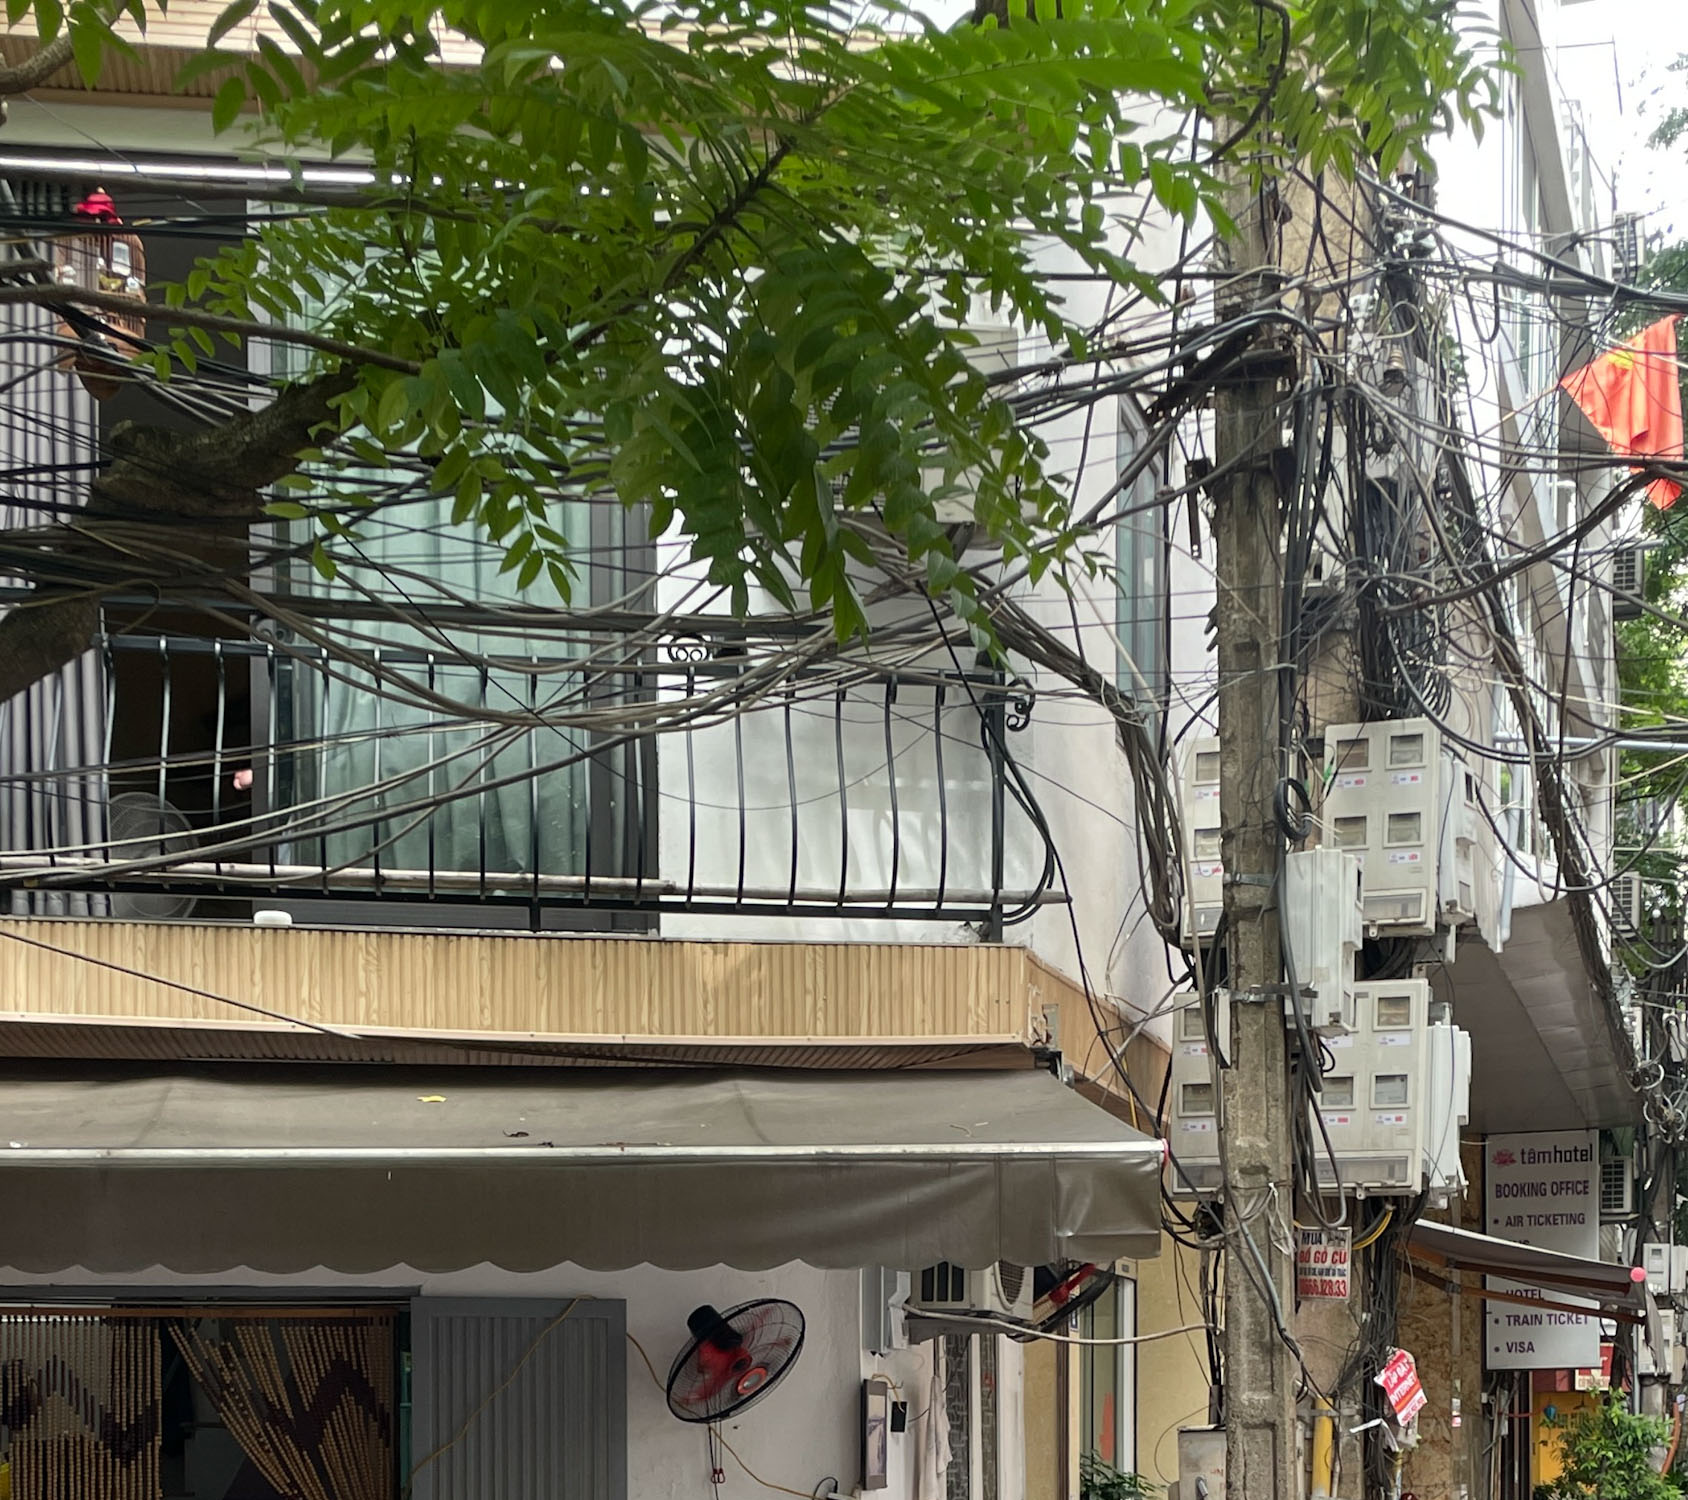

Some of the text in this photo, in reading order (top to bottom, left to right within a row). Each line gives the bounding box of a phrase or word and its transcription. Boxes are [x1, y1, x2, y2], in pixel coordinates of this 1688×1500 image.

[1495, 1180, 1590, 1198] BOOKING OFFICE
[1505, 1213, 1585, 1227] AIR TICKETING
[1505, 1313, 1588, 1326] TRAIN TICKET
[1506, 1341, 1535, 1353] VISA
